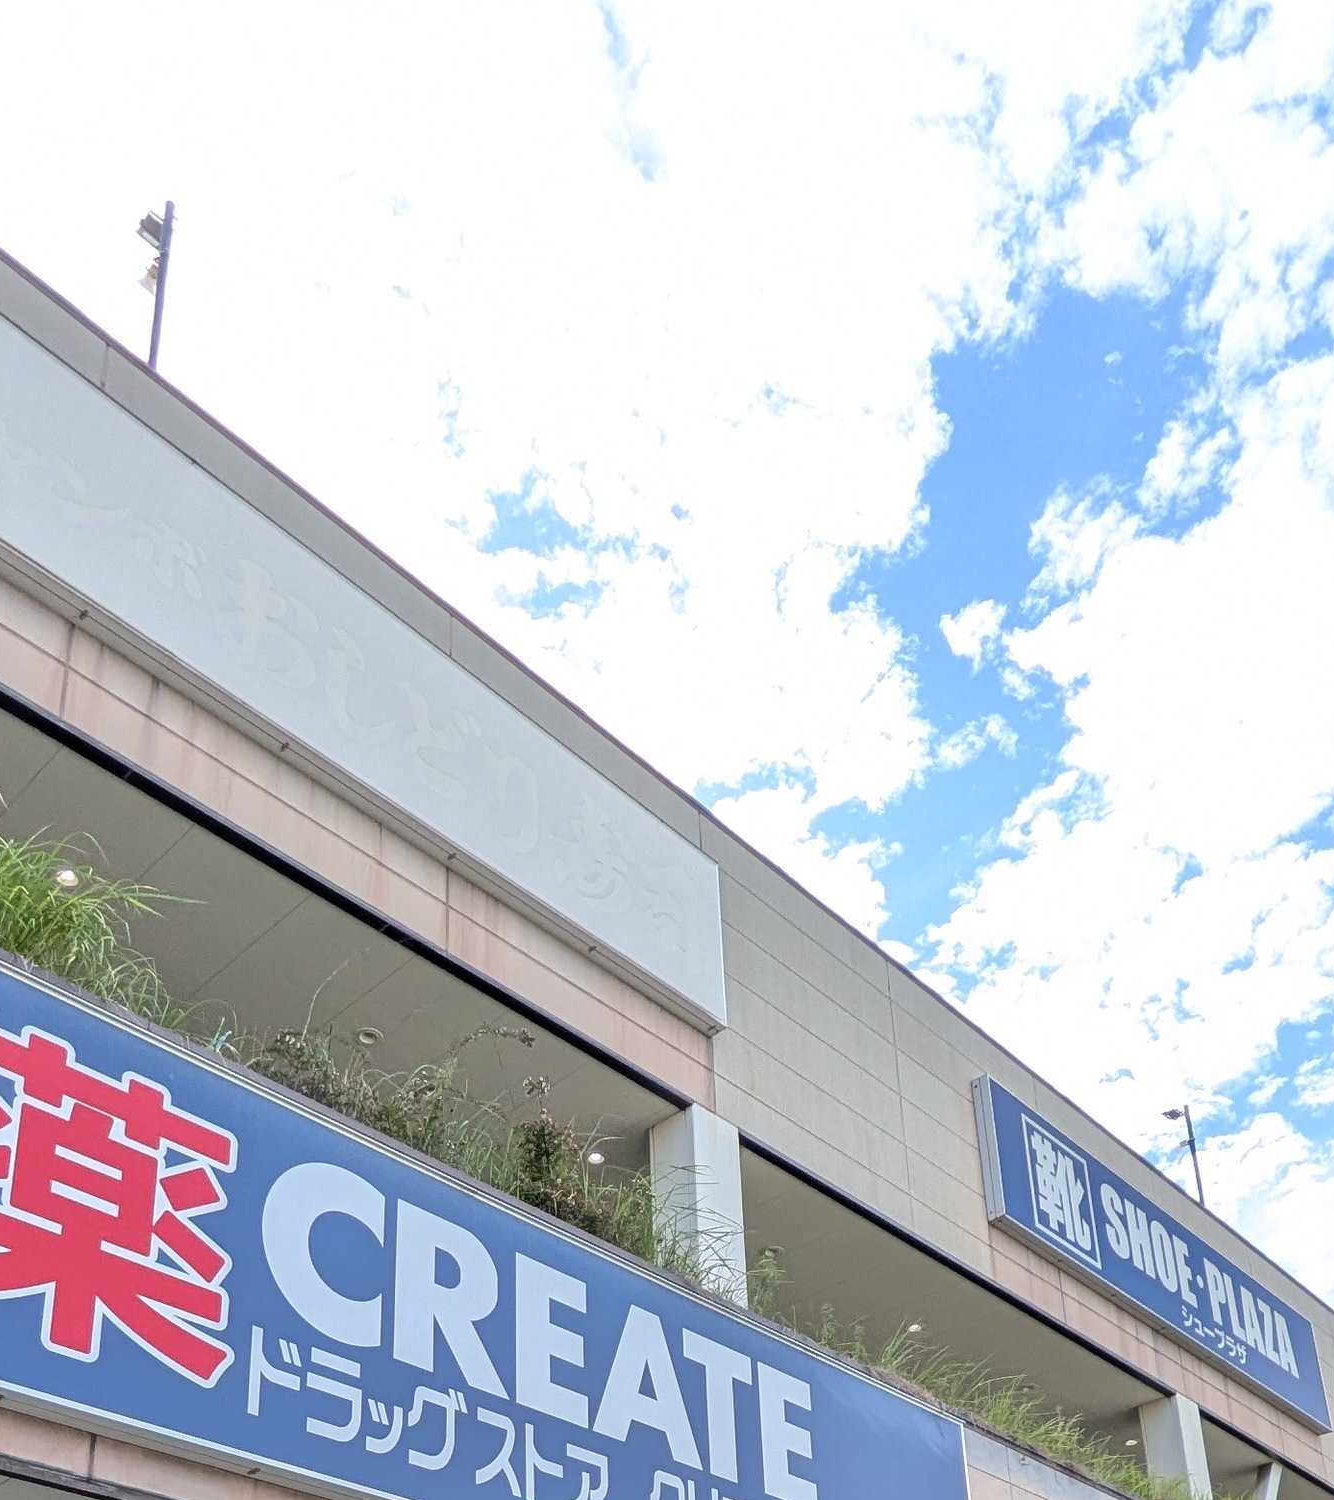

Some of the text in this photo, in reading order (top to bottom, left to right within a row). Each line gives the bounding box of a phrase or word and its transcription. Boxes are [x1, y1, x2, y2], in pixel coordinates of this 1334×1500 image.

[1032, 1129, 1093, 1252] 靴
[1182, 1306, 1249, 1366] シュープラザ
